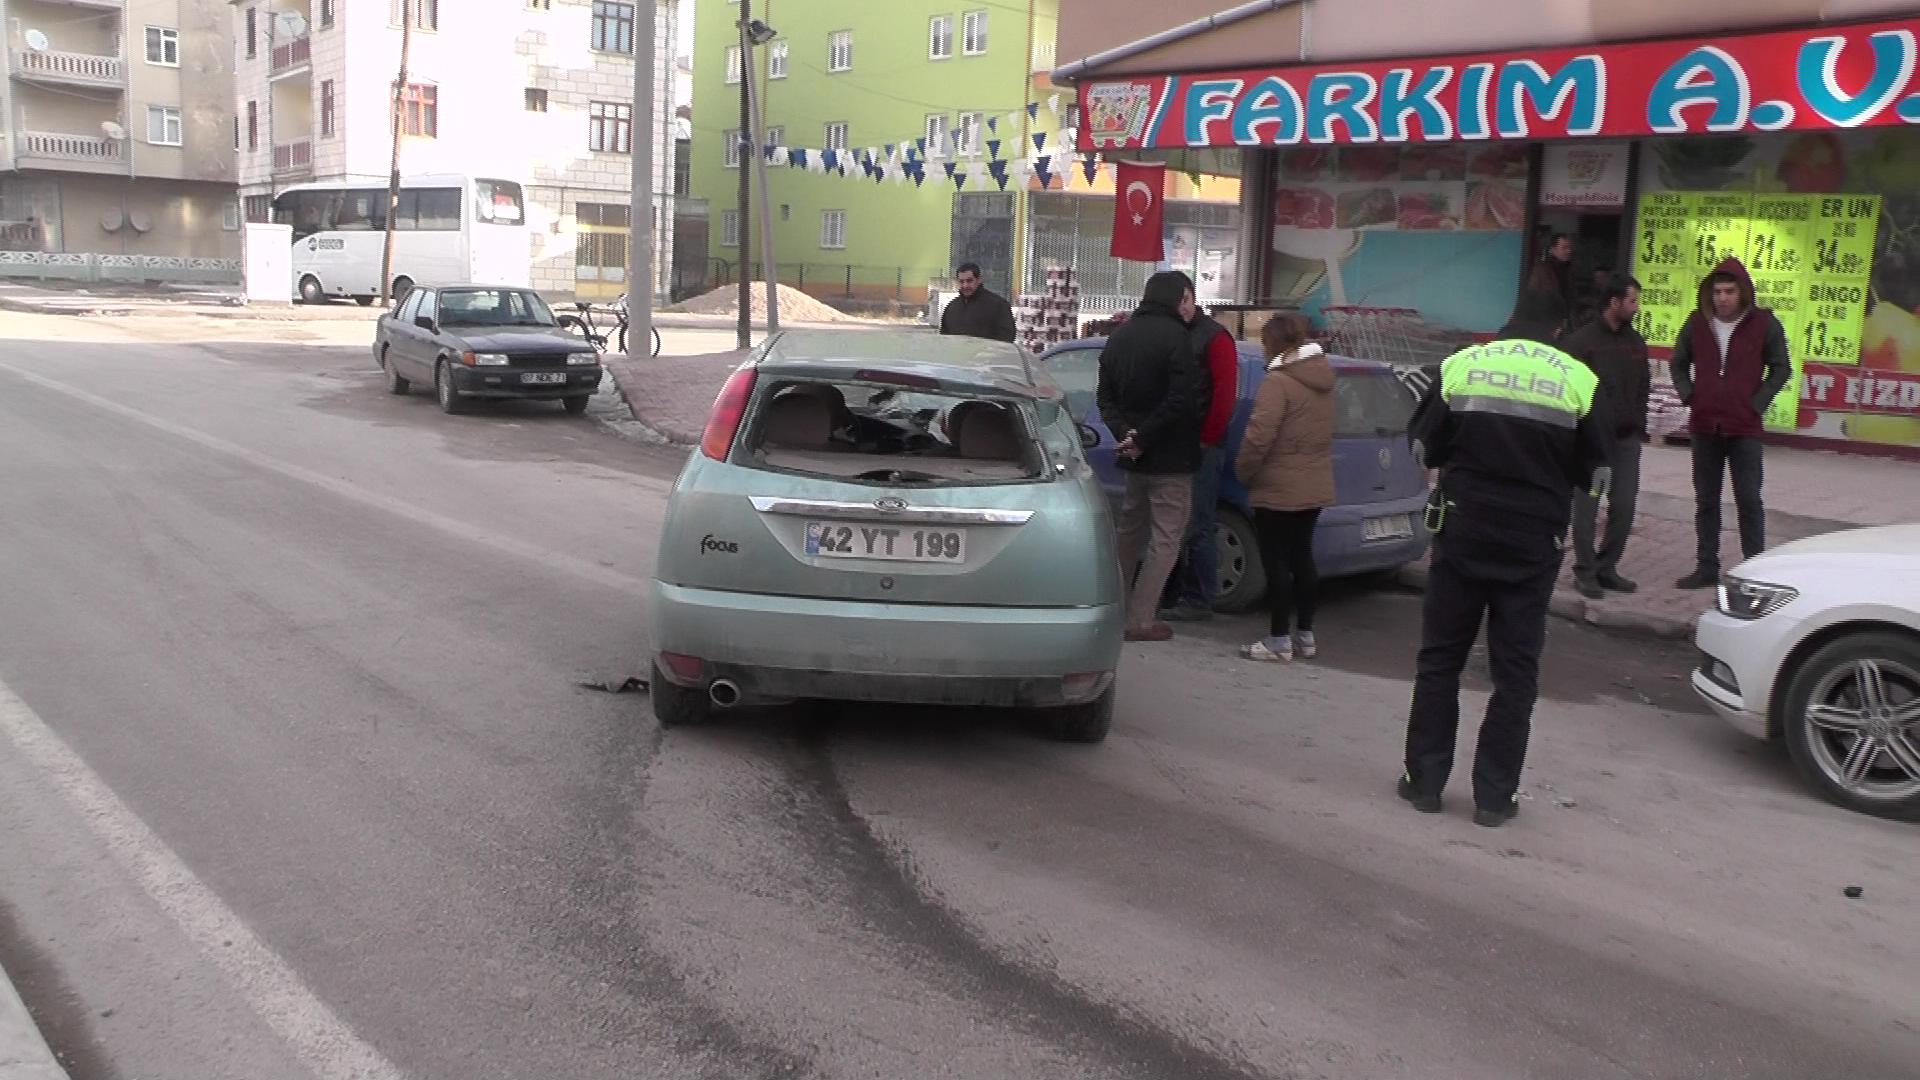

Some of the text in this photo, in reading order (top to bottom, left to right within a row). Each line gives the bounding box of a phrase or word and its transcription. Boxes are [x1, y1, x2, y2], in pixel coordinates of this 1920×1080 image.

[1184, 54, 1607, 146] FARKIM
[1821, 198, 1873, 219] ER UN
[819, 526, 960, 560] 42 YT 199
